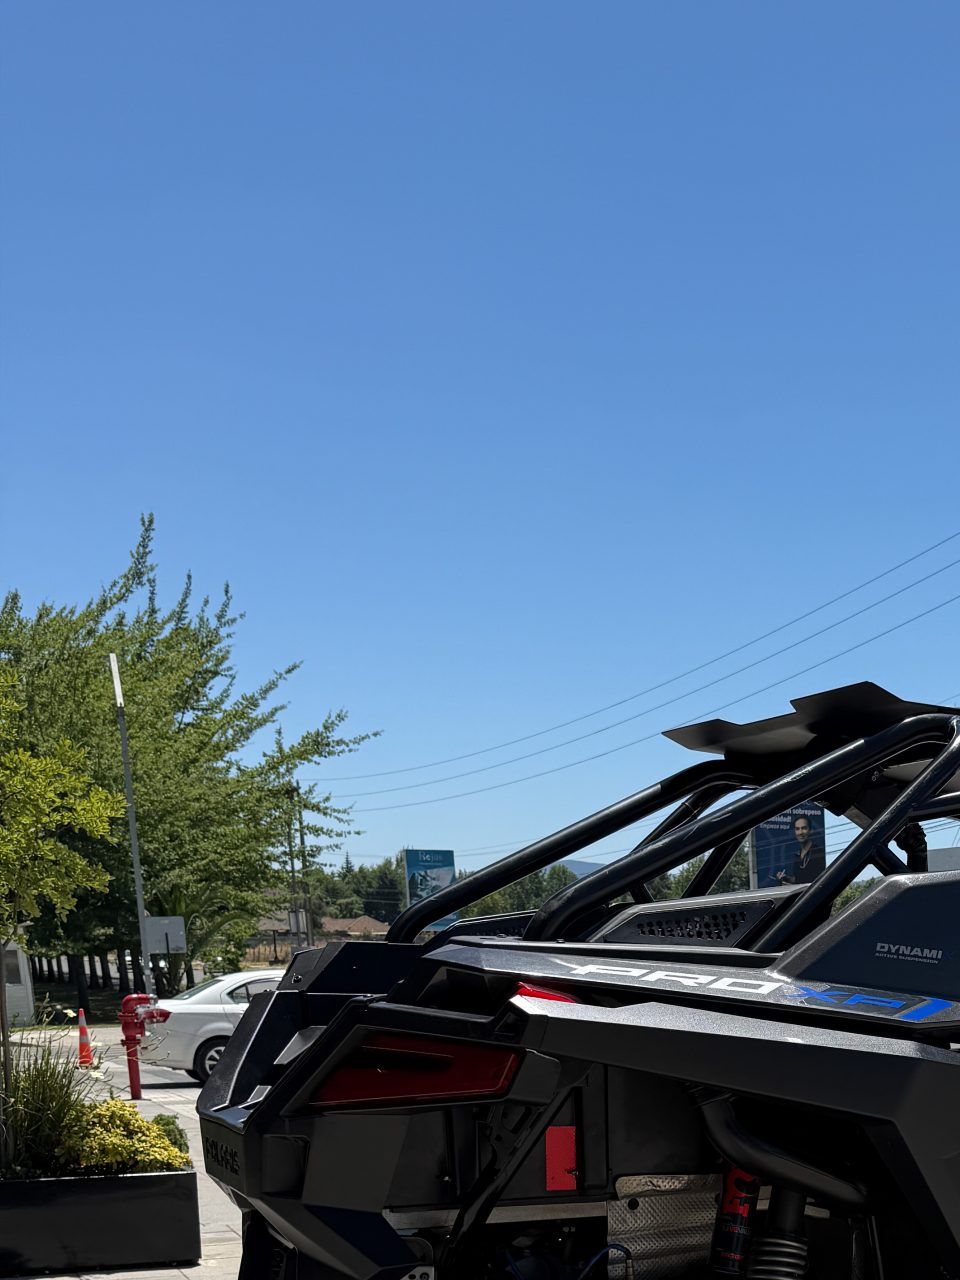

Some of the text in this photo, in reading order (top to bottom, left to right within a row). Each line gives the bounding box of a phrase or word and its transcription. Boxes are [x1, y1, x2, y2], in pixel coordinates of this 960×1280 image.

[898, 955, 939, 964] SUSPENSION
[570, 965, 907, 1009] PRO XP
